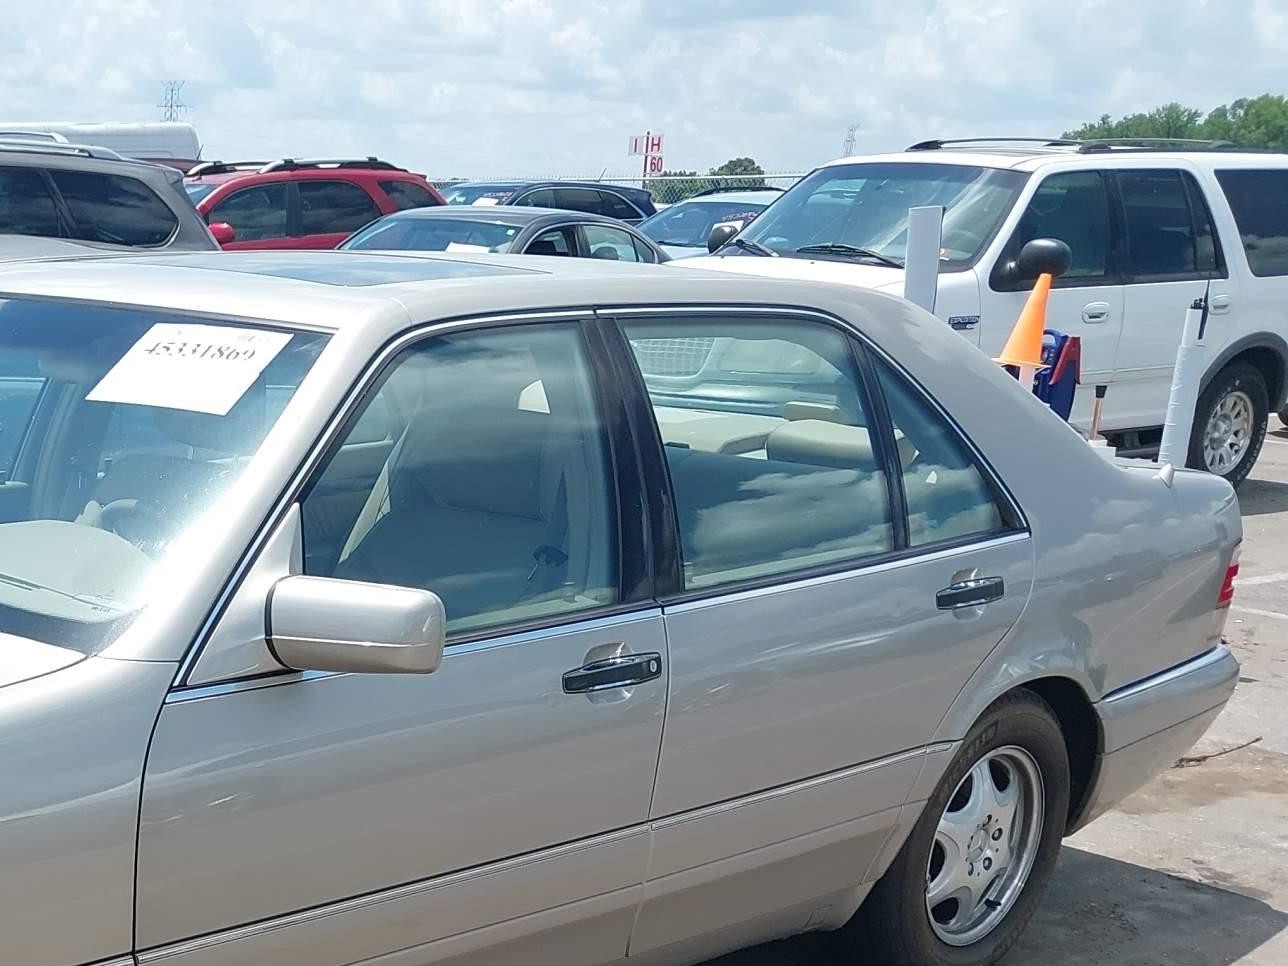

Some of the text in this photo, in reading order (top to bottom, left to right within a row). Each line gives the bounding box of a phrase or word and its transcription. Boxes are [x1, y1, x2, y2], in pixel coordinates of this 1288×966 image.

[650, 136, 661, 152] H
[650, 156, 663, 172] 60
[144, 342, 256, 360] 45331869
